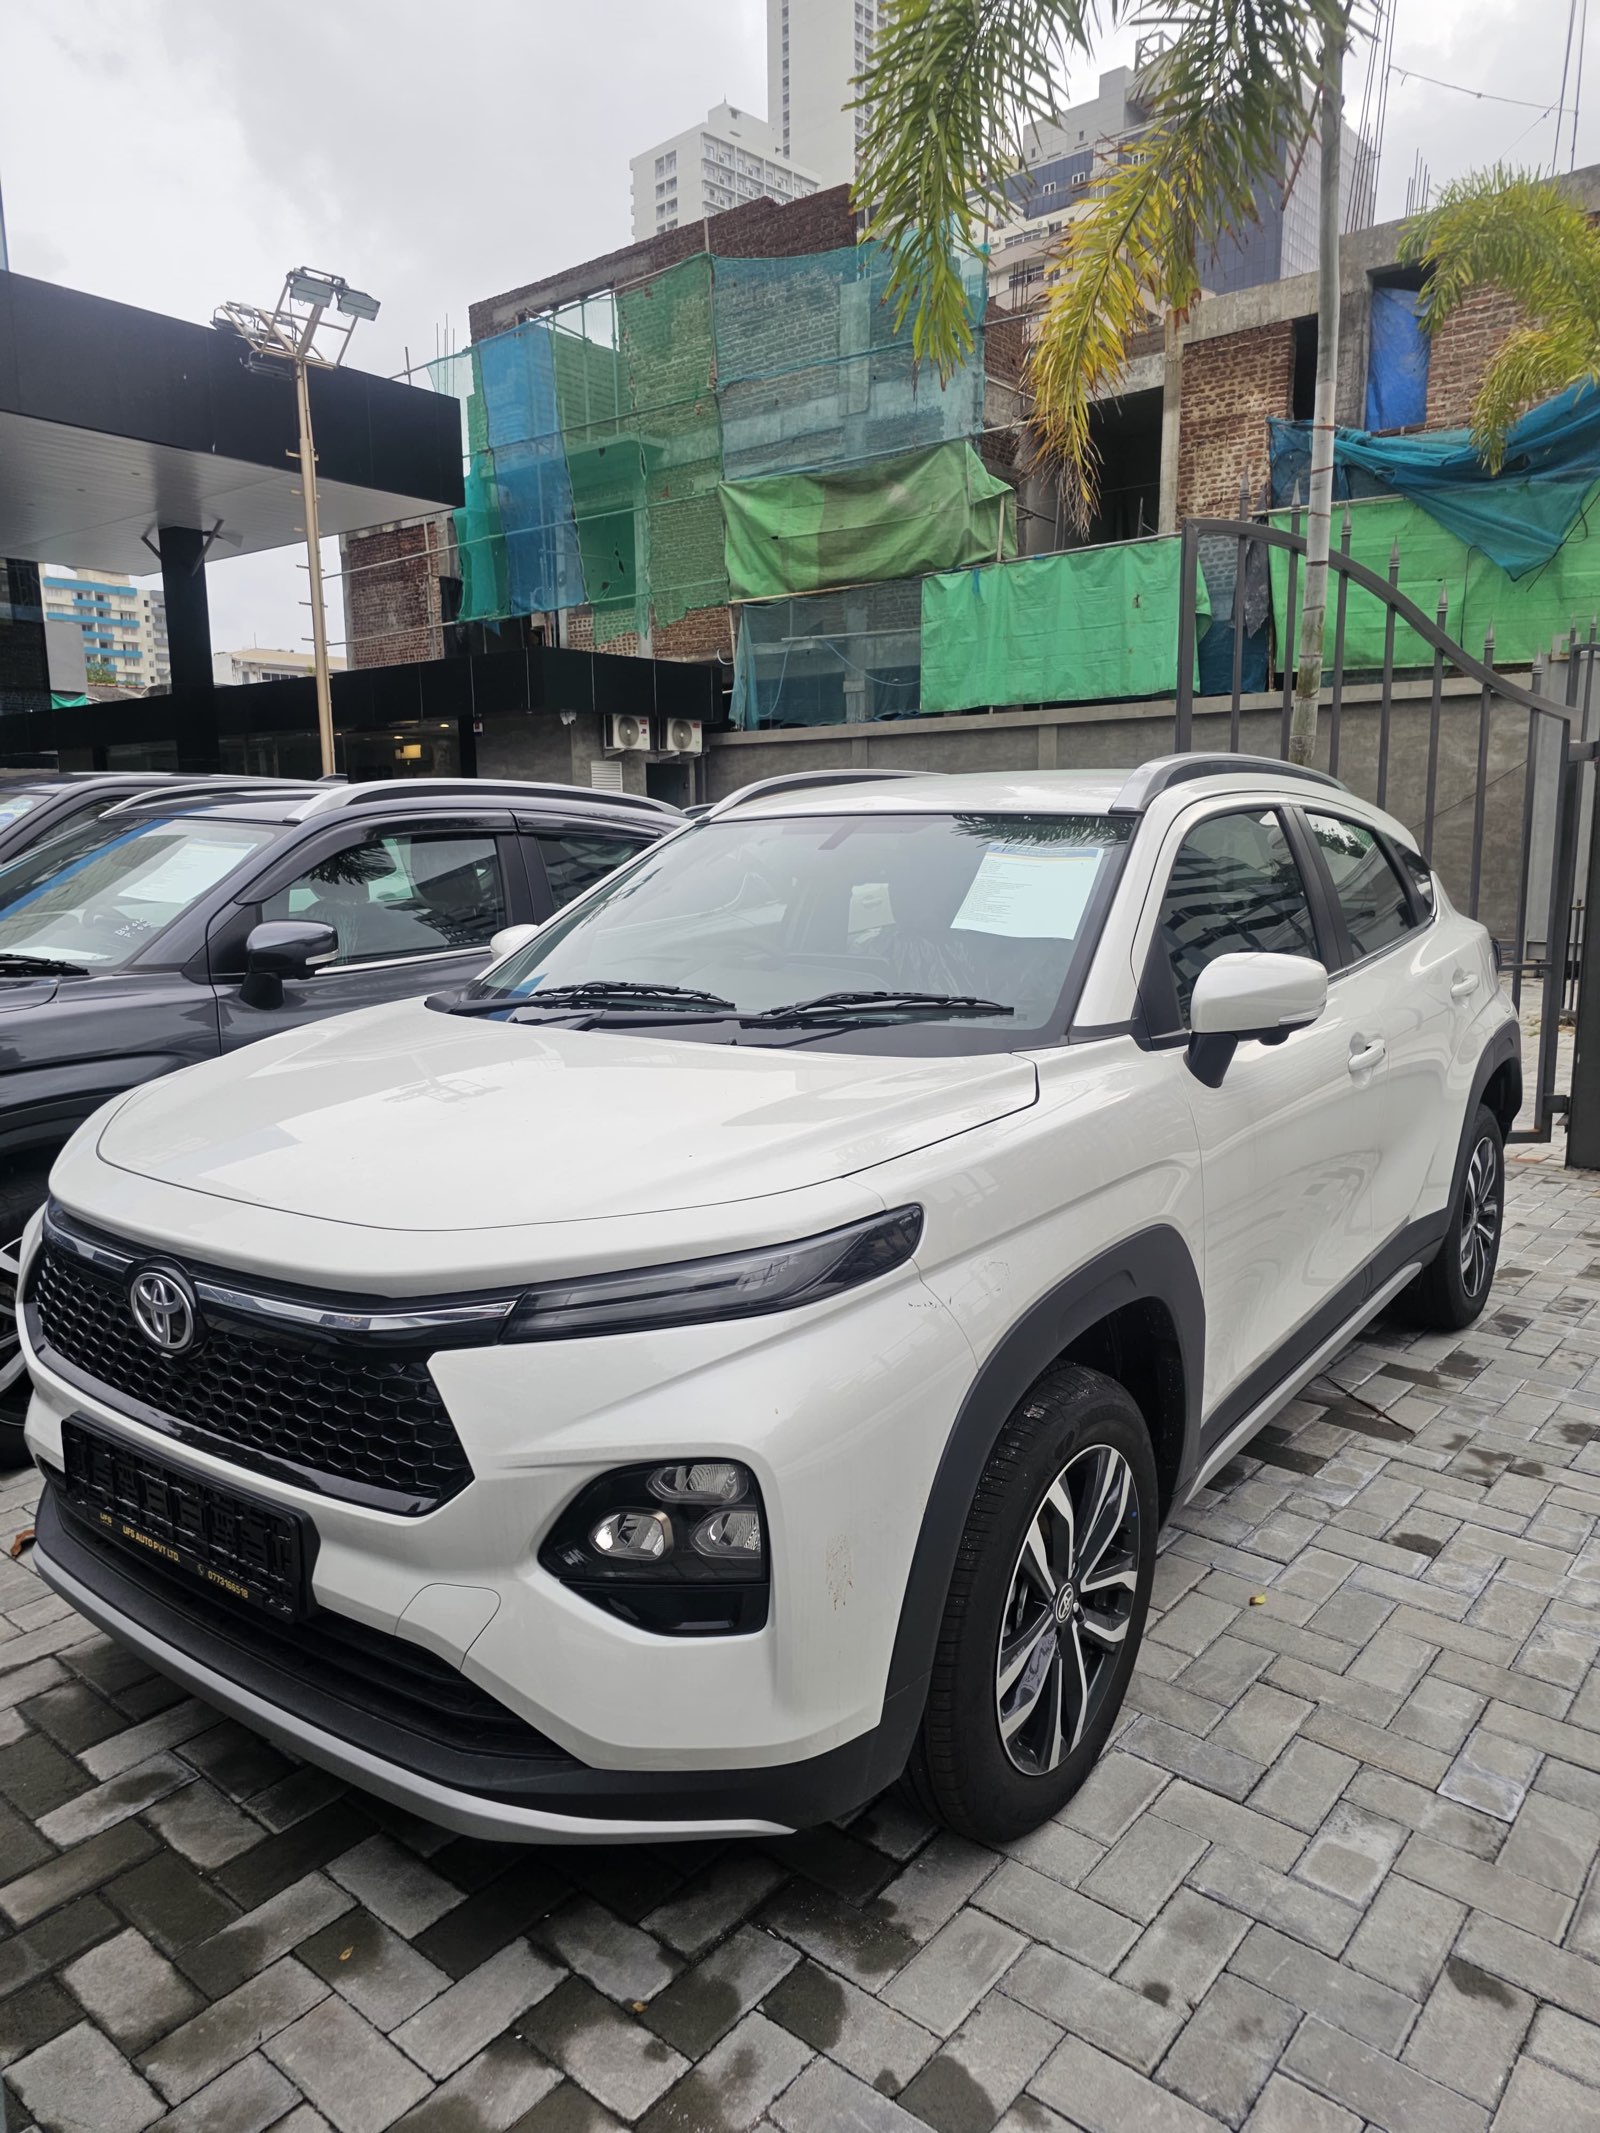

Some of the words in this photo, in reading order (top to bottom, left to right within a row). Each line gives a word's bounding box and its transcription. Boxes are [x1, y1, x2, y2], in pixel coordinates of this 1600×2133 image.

[122, 1524, 136, 1539] UFS
[135, 1532, 154, 1548] AUTO
[153, 1541, 167, 1556] PVT
[166, 1548, 181, 1563] LTD.
